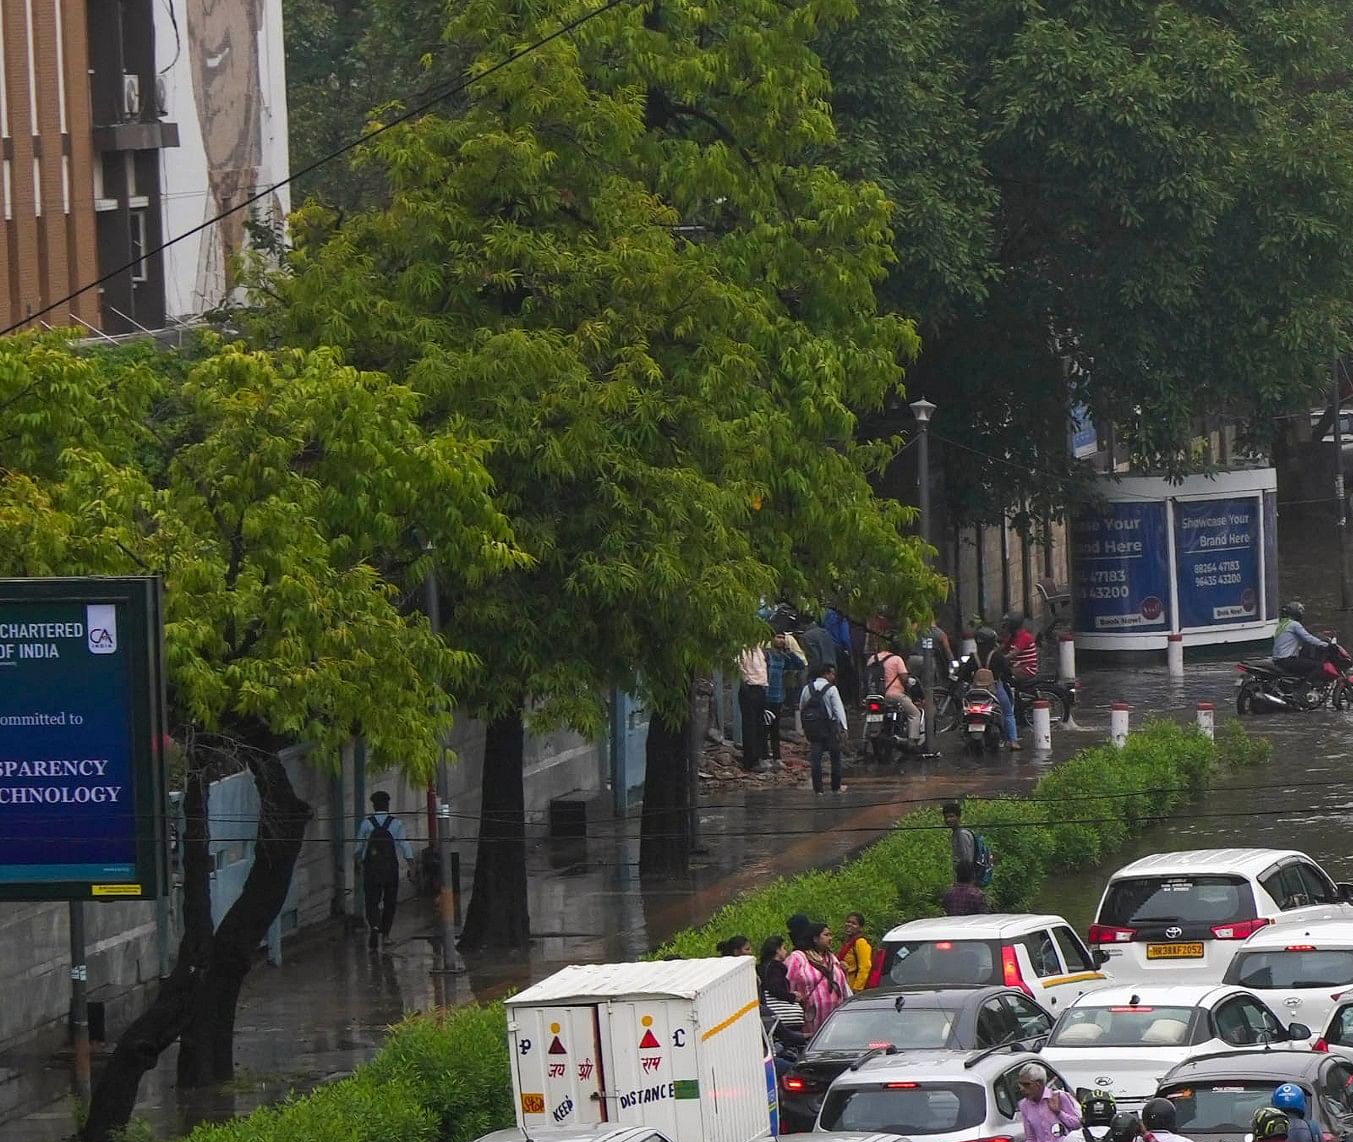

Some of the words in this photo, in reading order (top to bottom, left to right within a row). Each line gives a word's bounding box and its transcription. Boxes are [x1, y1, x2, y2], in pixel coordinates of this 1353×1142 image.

[1105, 518, 1142, 531] Your
[1182, 517, 1228, 529] Showcase
[1230, 513, 1249, 524] Your
[1104, 540, 1143, 553] Here
[1200, 535, 1228, 548] Brand
[1229, 532, 1250, 544] Here
[1194, 563, 1217, 574] 88264
[1219, 560, 1240, 572] 47183
[1194, 576, 1217, 587] 96435
[1218, 573, 1242, 585] 43200
[1089, 585, 1130, 599] 43200
[0, 622, 83, 638] CHARTERED
[89, 628, 113, 645] CA
[19, 644, 59, 659] INDIA
[68, 714, 83, 726] to
[0, 786, 121, 804] CHNOLOGY
[547, 1062, 566, 1079] जय
[640, 1055, 663, 1074] राम
[619, 1084, 675, 1110] DISTANCE
[552, 1097, 574, 1122] KEEP
